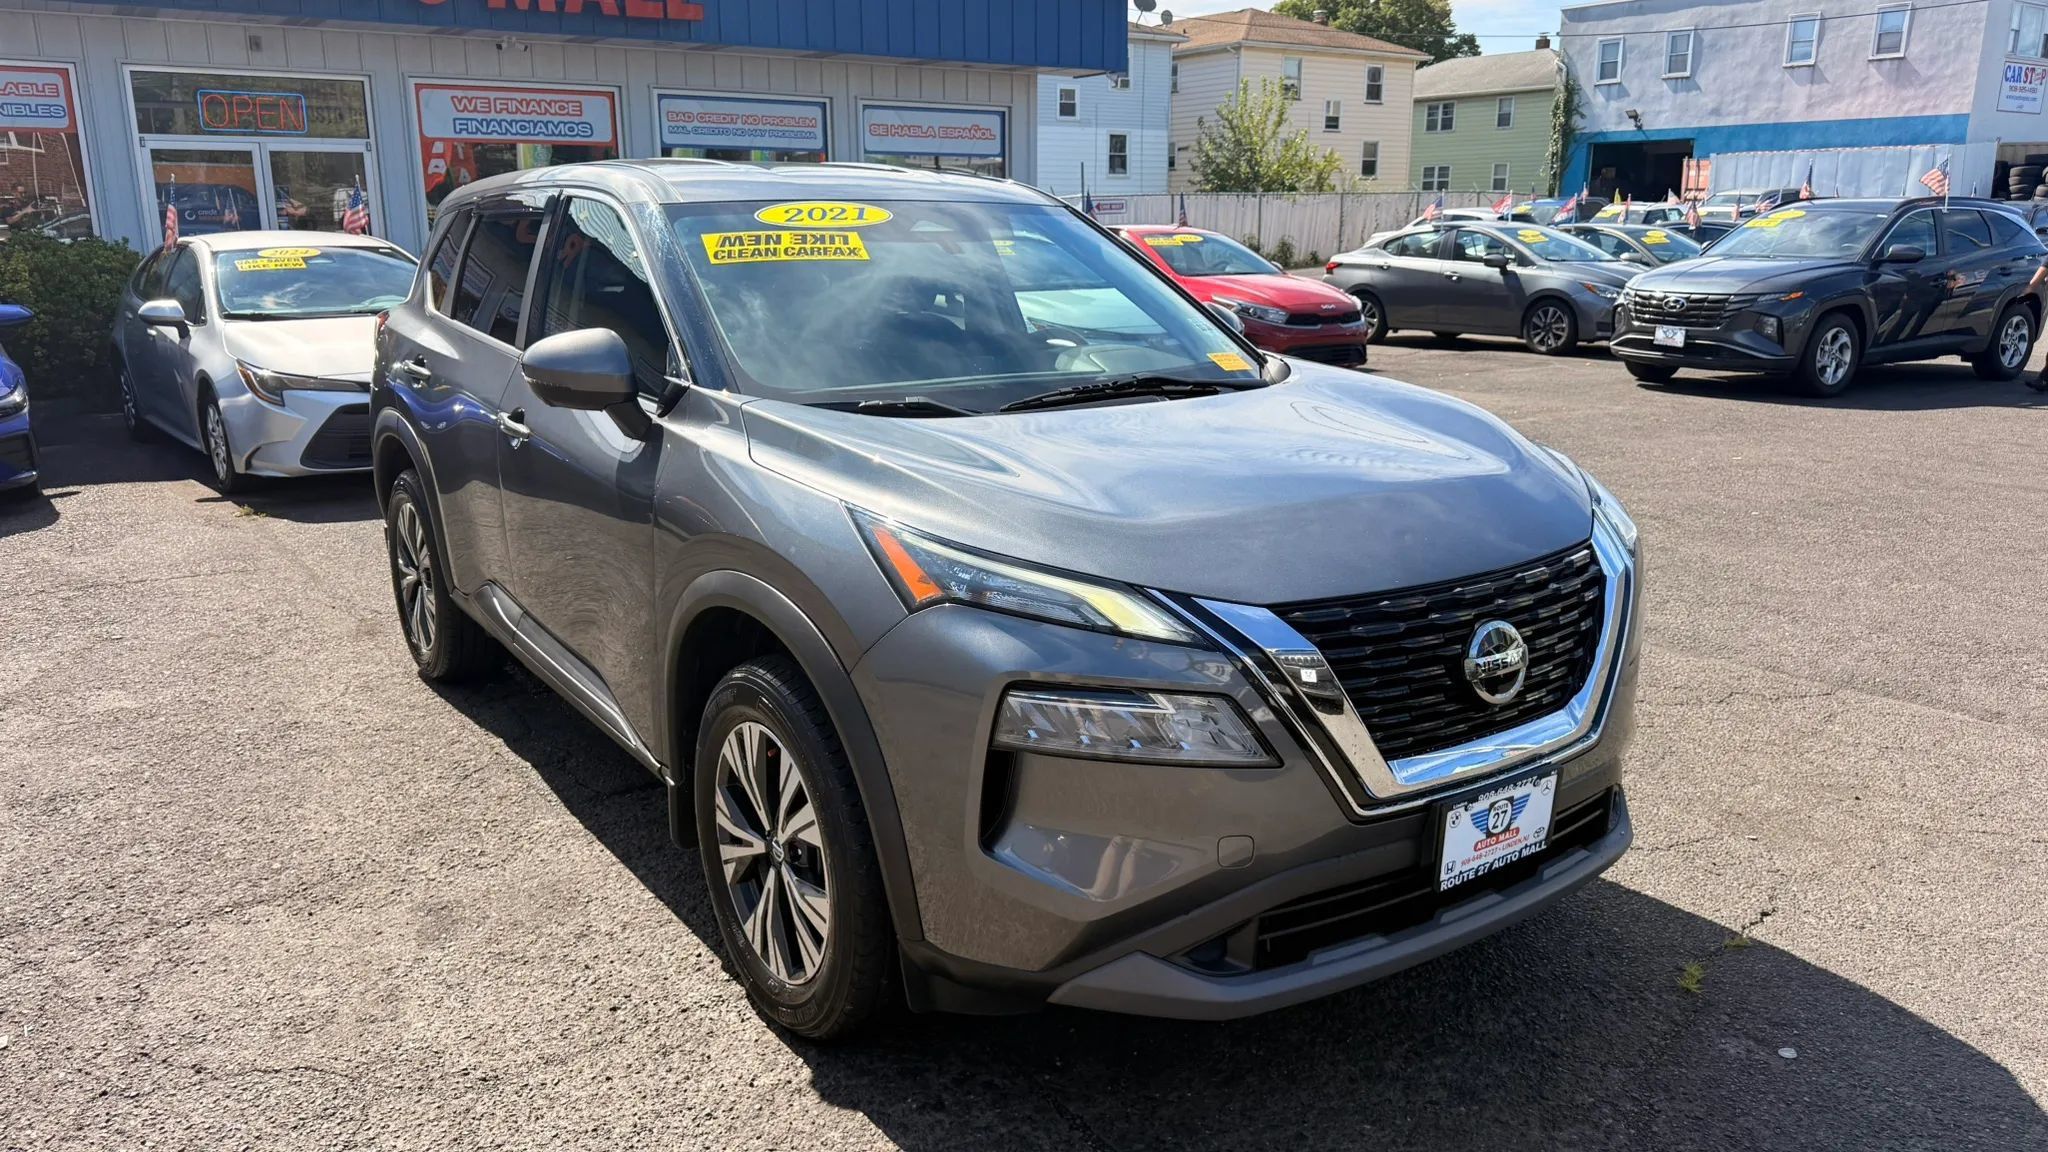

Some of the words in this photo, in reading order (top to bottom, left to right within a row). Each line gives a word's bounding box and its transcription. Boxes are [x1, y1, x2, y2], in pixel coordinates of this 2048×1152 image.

[2005, 65, 2022, 83] CAR
[203, 94, 304, 130] OPEN
[451, 96, 491, 113] WE
[494, 97, 582, 116] FINANCE
[453, 118, 593, 138] FINANCIAMOS
[667, 111, 694, 123] BAD
[697, 112, 739, 124] CREDIT
[742, 114, 761, 125] NO
[763, 115, 817, 128] PROBLEM
[668, 126, 690, 135] MAL
[732, 128, 747, 137] NO
[748, 128, 767, 138] HAY
[768, 129, 816, 139] PROBLEMA
[869, 124, 889, 136] SE
[890, 124, 936, 138] HABLA
[938, 124, 996, 140] ESPAÑOL
[784, 207, 869, 223] 2021
[717, 233, 782, 247] NEW
[790, 233, 850, 246] LIKE
[713, 247, 778, 260] CLEAN
[783, 246, 861, 258] CARFAX
[1475, 653, 1521, 673] NISSAN
[1493, 802, 1509, 812] ROUTE
[1491, 808, 1508, 831] 27
[1475, 836, 1497, 850] AUTO
[1498, 829, 1517, 842] MALL
[1440, 870, 1475, 892] ROUTE
[1478, 864, 1490, 876] 27
[1492, 852, 1518, 870] AUTO
[1521, 841, 1547, 858] MALL
